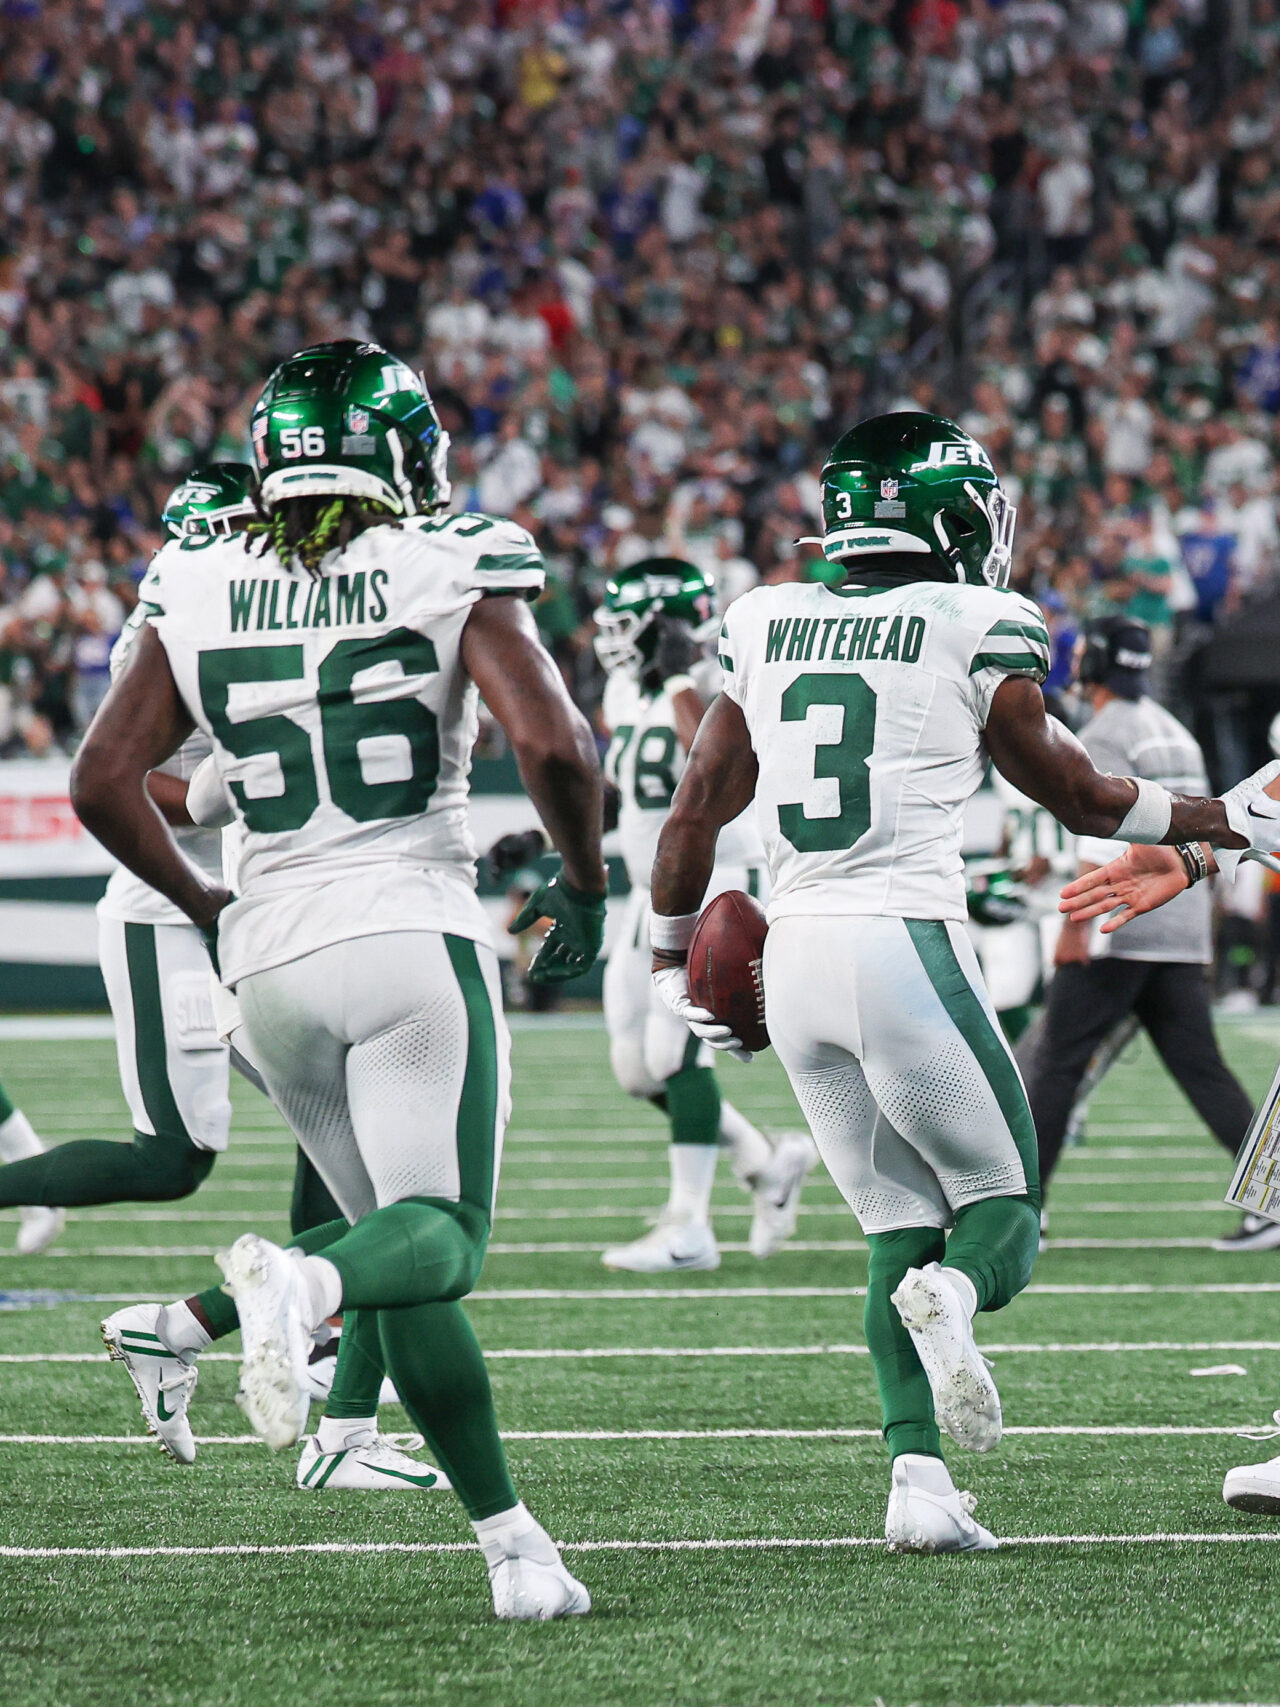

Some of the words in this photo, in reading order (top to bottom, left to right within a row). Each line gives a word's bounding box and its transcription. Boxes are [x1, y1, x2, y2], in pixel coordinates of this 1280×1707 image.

[280, 426, 326, 459] 56
[836, 493, 852, 519] 3
[229, 569, 388, 632] WILLIAMS
[765, 615, 926, 664] WHITEHEAD
[198, 626, 440, 834] 56
[777, 673, 877, 853] 3
